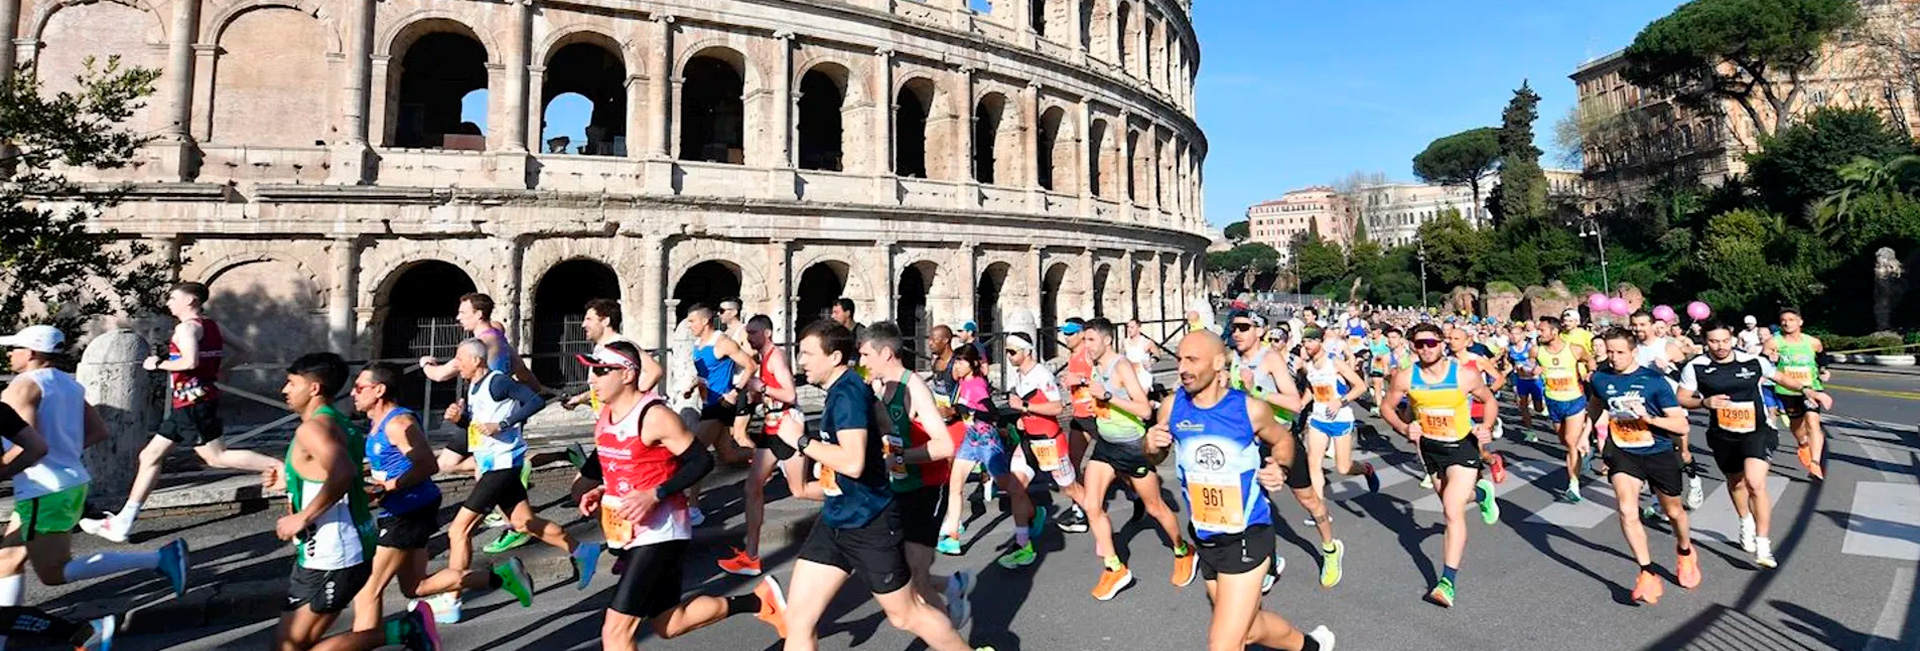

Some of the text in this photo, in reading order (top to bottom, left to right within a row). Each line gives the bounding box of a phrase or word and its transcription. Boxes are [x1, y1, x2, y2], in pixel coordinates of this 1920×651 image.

[1721, 408, 1750, 420] 12900
[1426, 415, 1448, 427] 6794
[1202, 487, 1225, 508] 961
